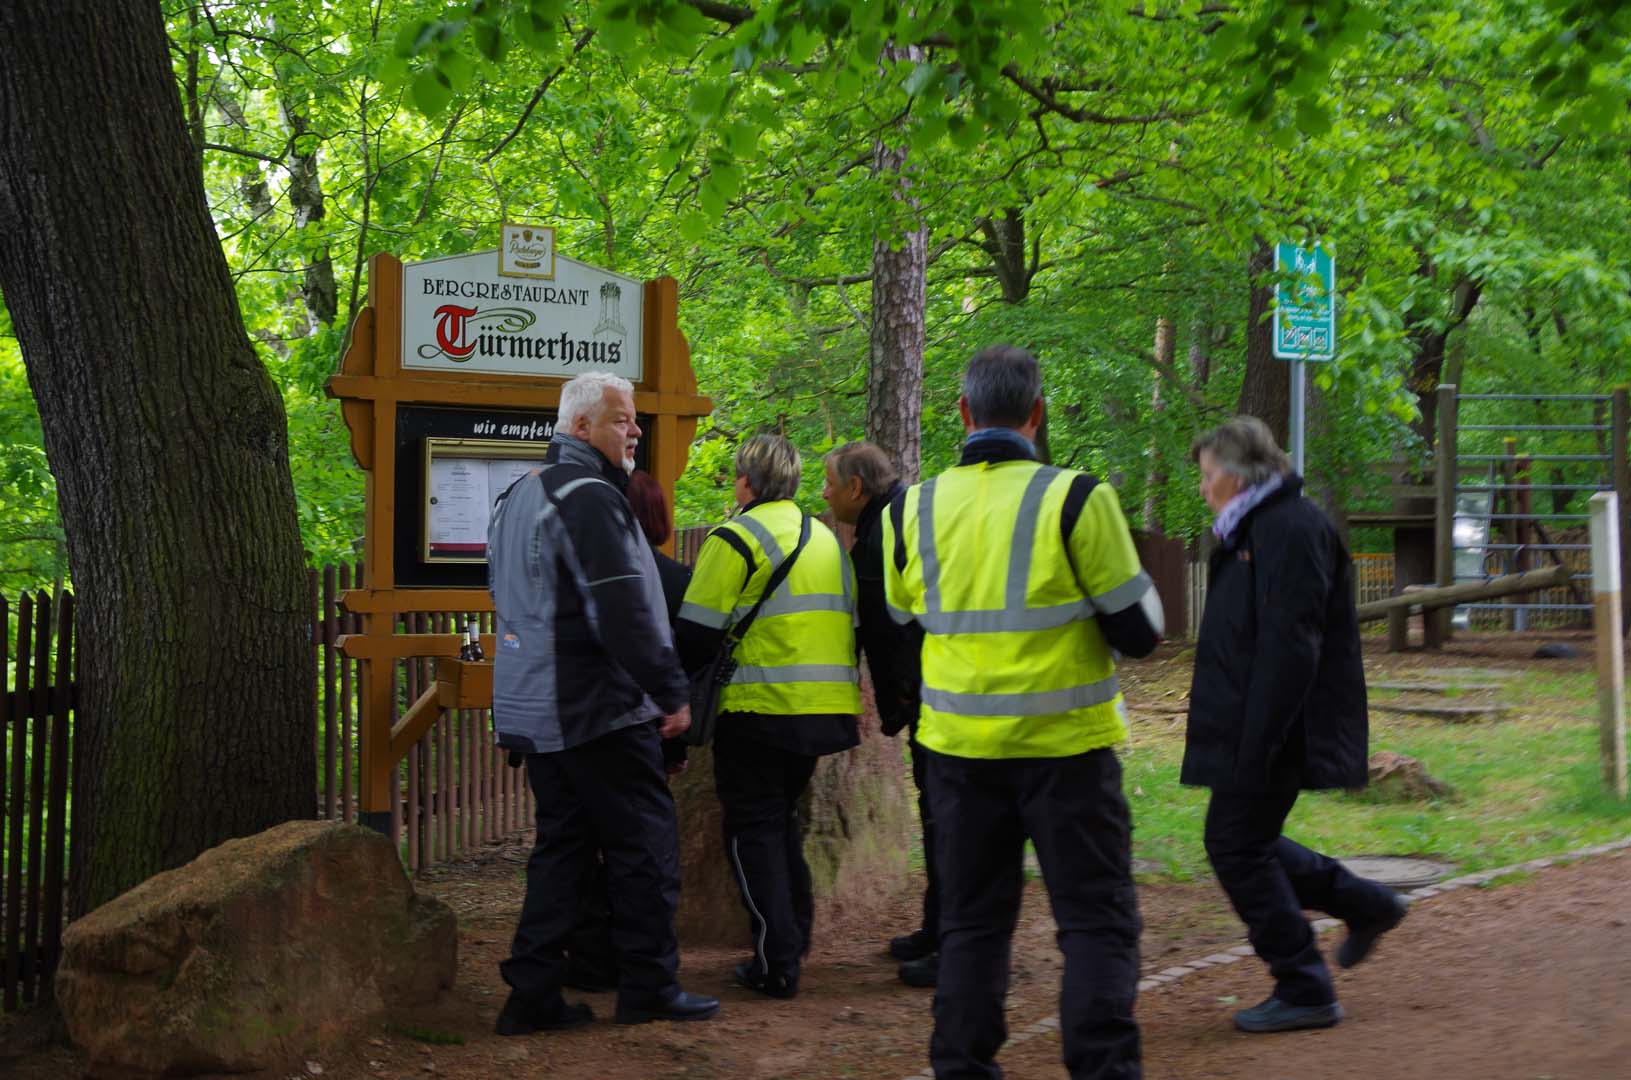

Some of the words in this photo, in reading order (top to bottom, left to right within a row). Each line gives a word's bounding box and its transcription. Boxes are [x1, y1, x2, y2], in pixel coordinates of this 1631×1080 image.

[423, 278, 589, 306] BERGRESTAURANT
[432, 304, 622, 366] Türmerhaus
[473, 420, 496, 434] wir
